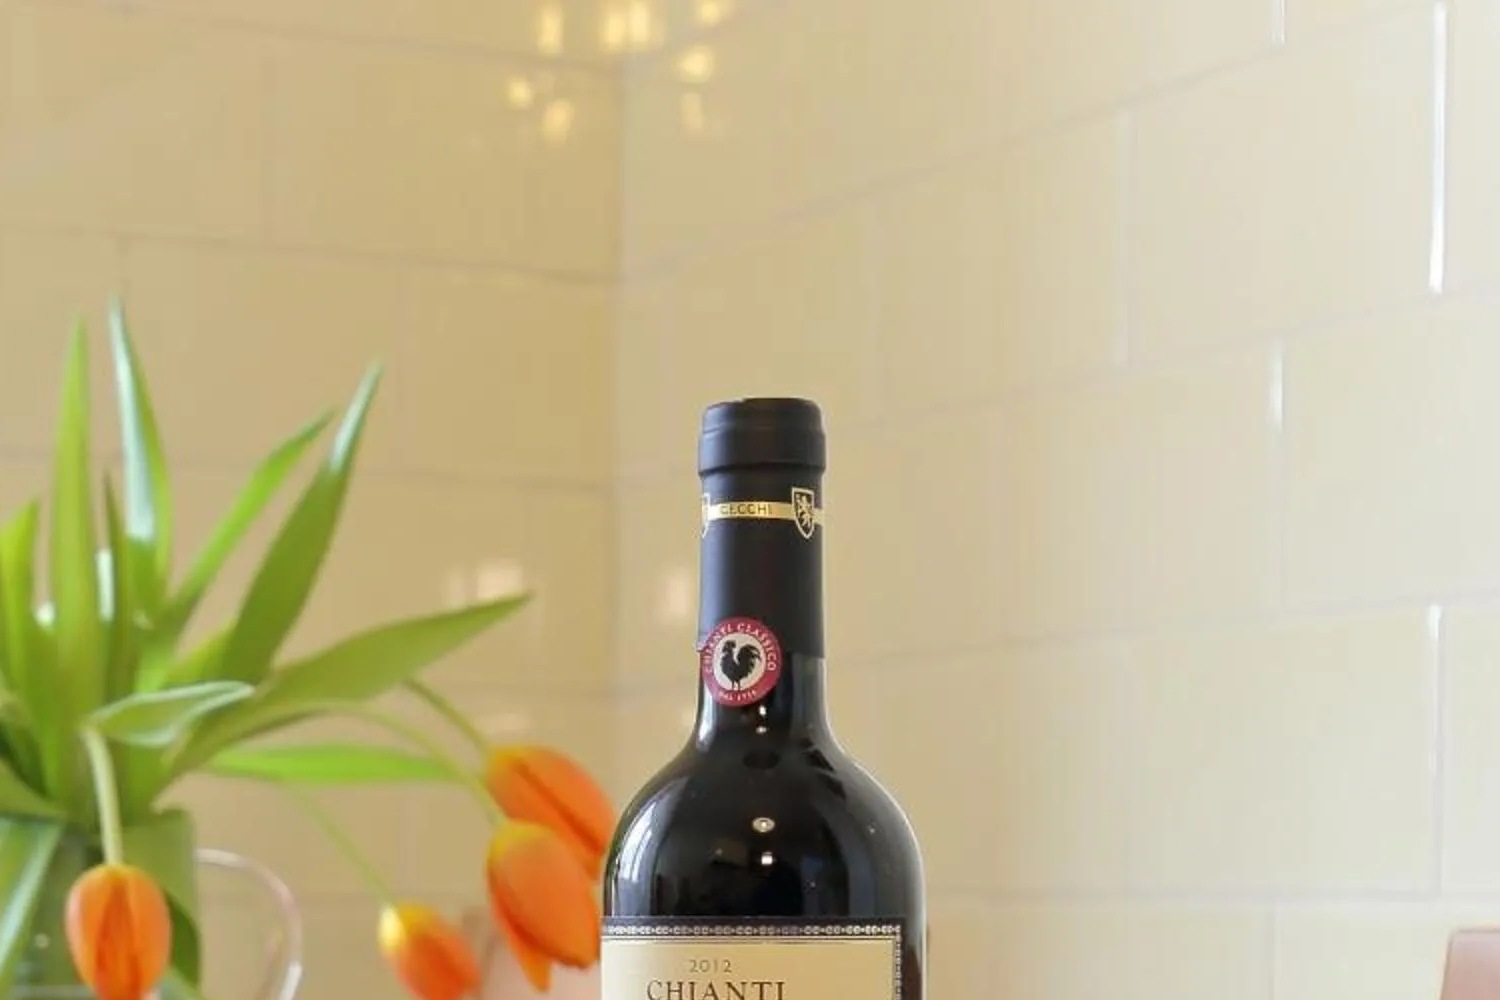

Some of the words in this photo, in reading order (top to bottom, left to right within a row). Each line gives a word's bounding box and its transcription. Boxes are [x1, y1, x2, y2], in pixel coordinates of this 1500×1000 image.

[719, 503, 773, 516] CECCHI
[736, 622, 777, 672] CLASSICO
[688, 958, 733, 974] 2012
